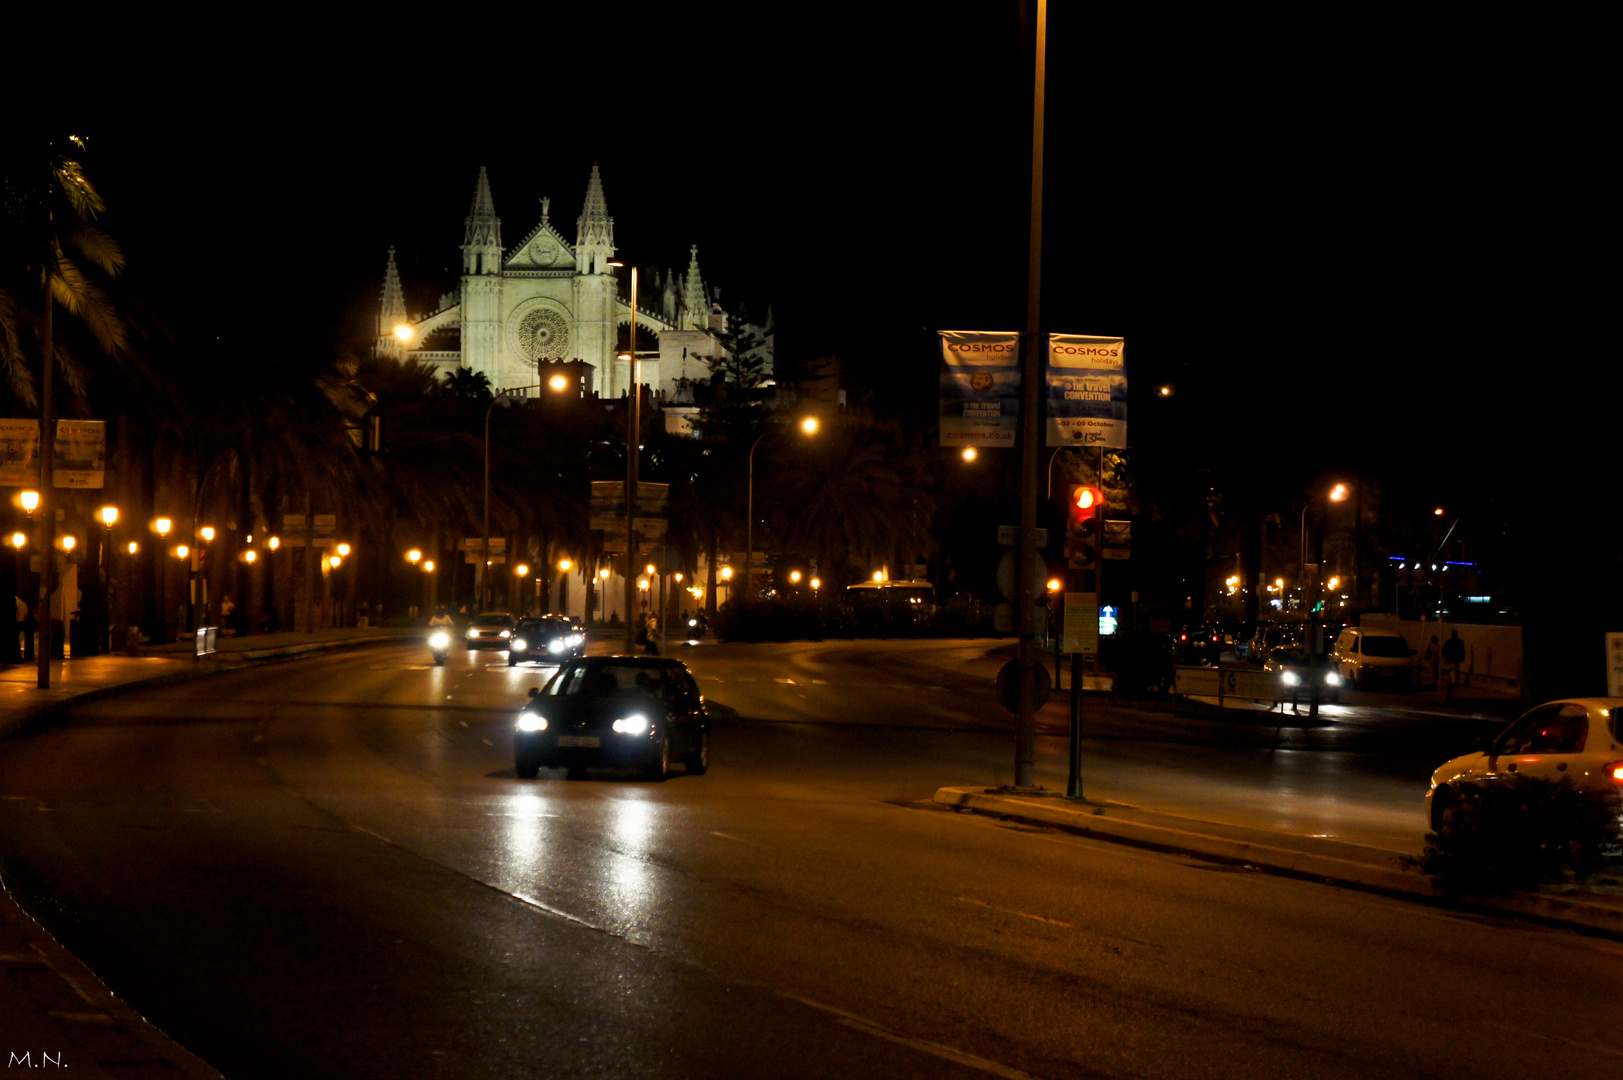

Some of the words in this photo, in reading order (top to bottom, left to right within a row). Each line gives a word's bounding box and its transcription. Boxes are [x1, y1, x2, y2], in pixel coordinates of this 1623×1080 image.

[948, 343, 1014, 352] COSMOS
[1053, 346, 1118, 357] COSMOS
[986, 353, 1014, 361] holidays
[1091, 357, 1119, 366] holidays
[1072, 382, 1085, 391] THE
[1086, 382, 1111, 392] travel
[1064, 391, 1111, 401] CONVENTION
[1087, 420, 1115, 428] October
[946, 431, 1013, 440] cosmos.co.uk
